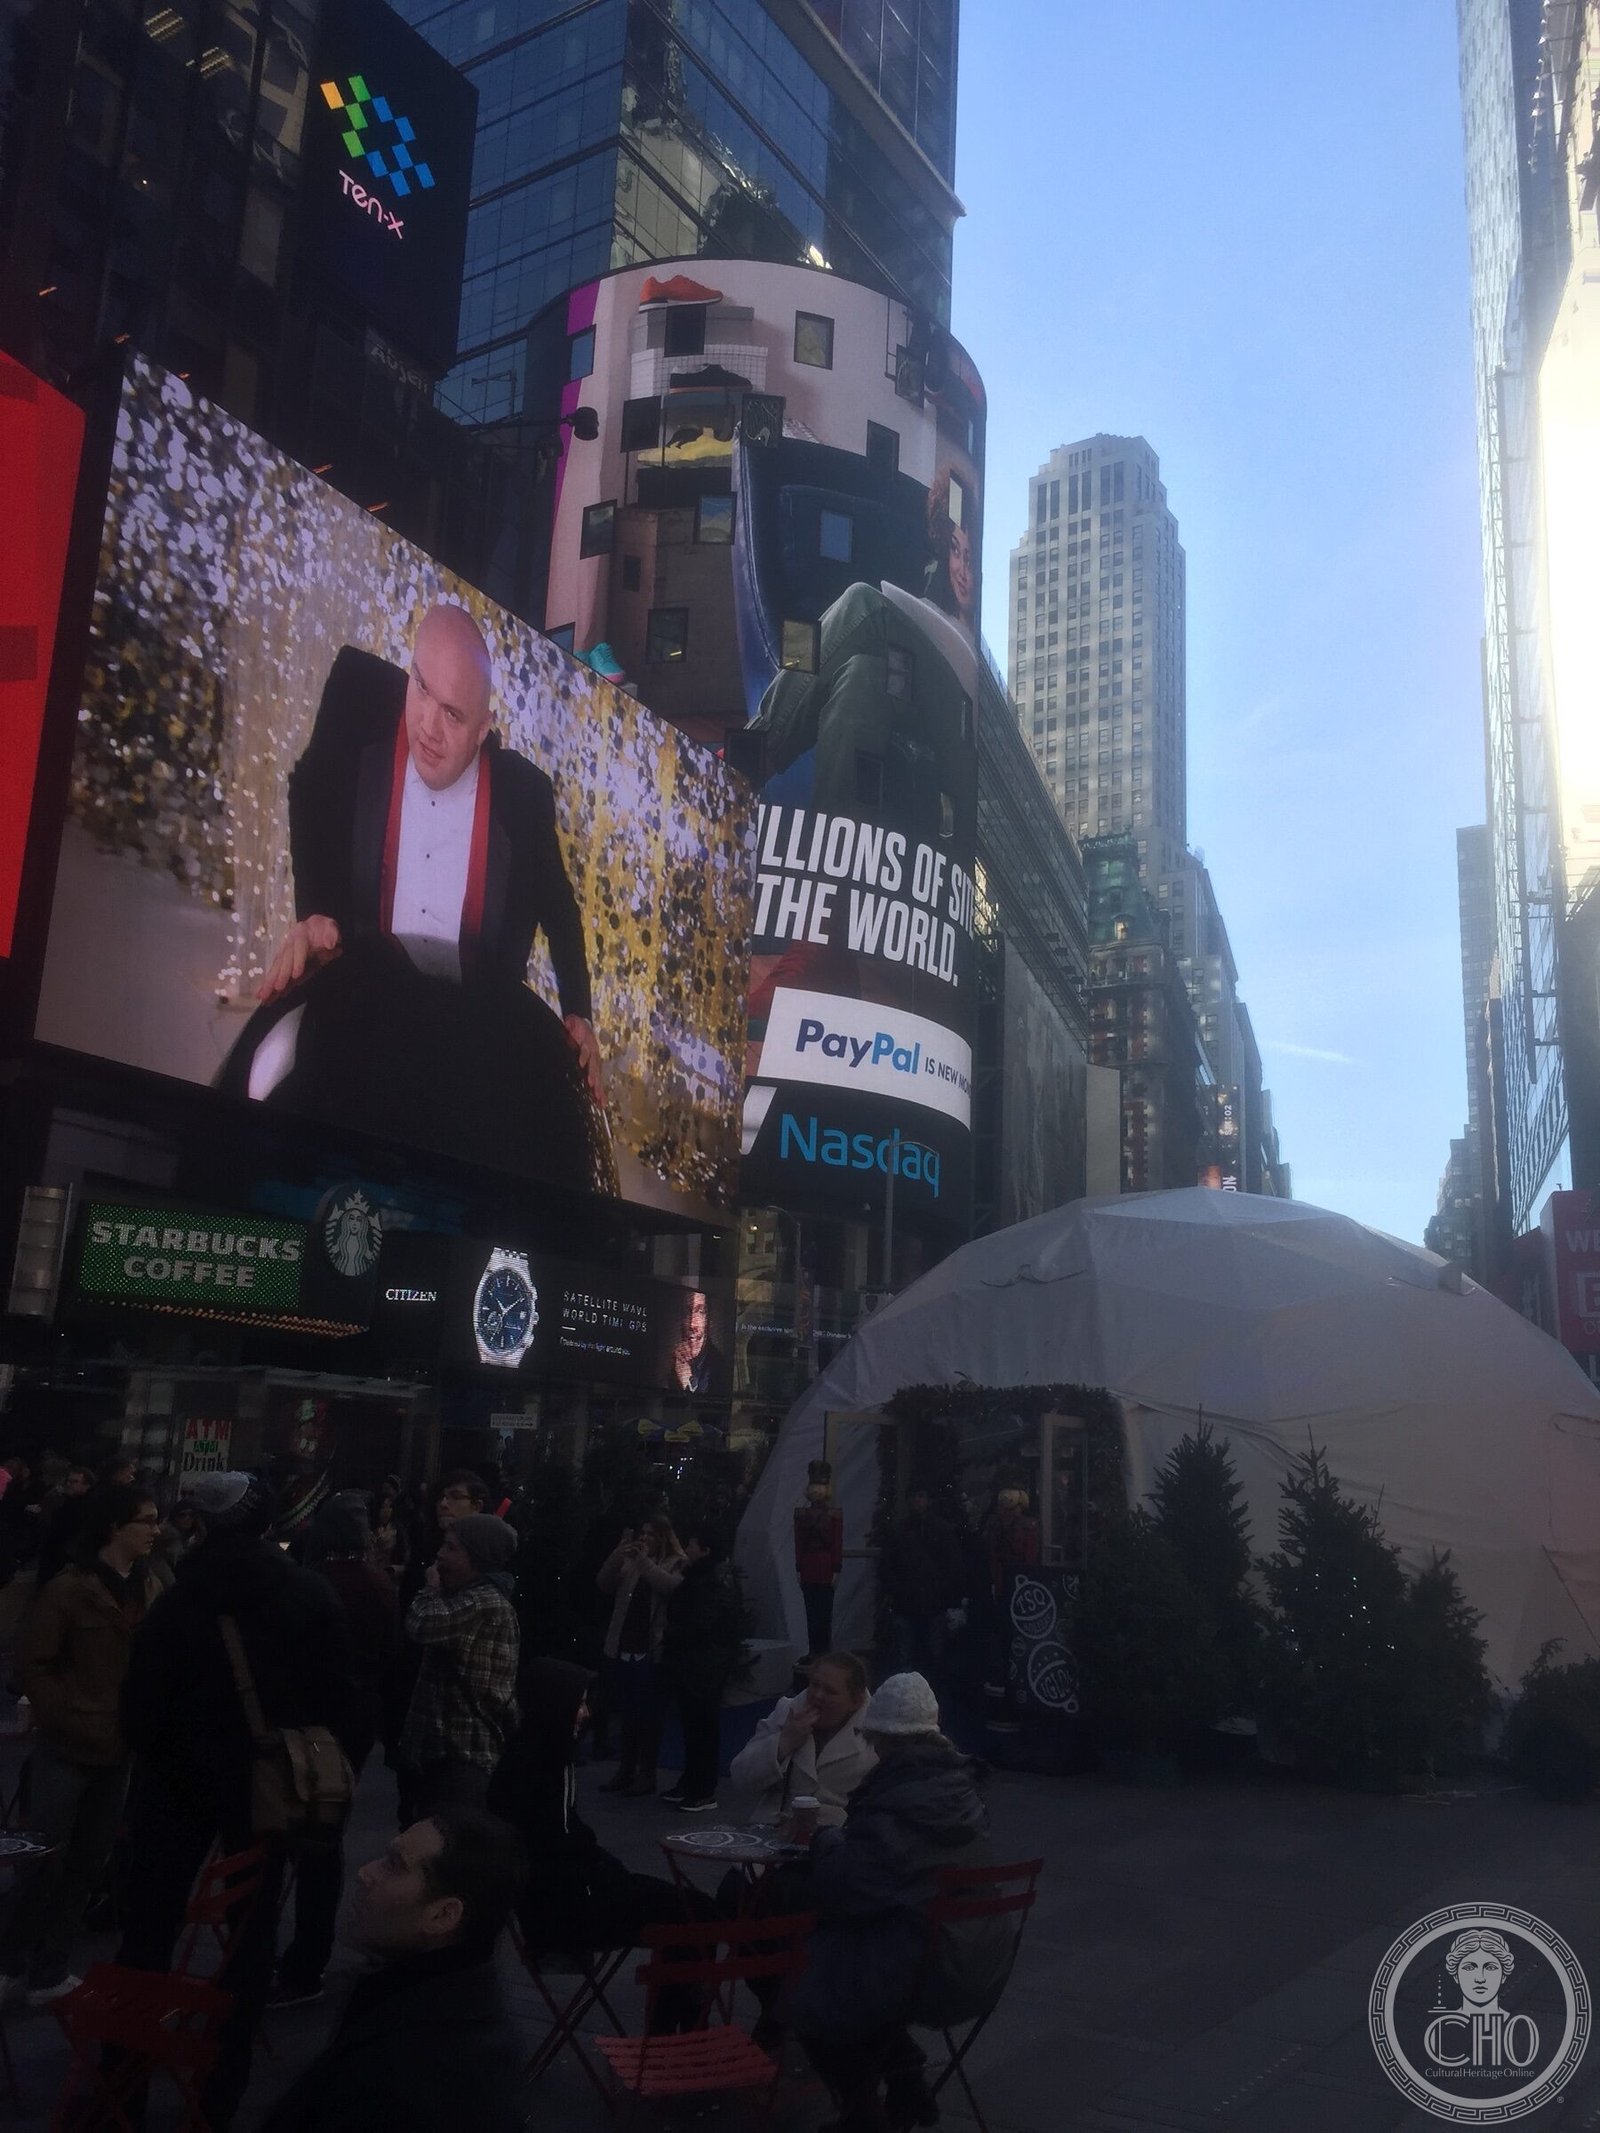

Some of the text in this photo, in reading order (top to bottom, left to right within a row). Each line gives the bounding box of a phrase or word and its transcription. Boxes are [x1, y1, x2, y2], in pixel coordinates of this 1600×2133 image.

[912, 843, 947, 909] OF
[753, 873, 959, 988] THE WORLD.
[795, 1018, 921, 1075] PayPal
[925, 1056, 936, 1076] IS
[938, 1062, 959, 1086] NEW
[779, 1113, 941, 1199] Nasdaq
[91, 1220, 301, 1262] STARBUCKS
[123, 1255, 256, 1288] COFFEE
[385, 1288, 438, 1302] CITIZEN
[562, 1307, 598, 1324] WORLD
[563, 1290, 619, 1312] SATELLITE
